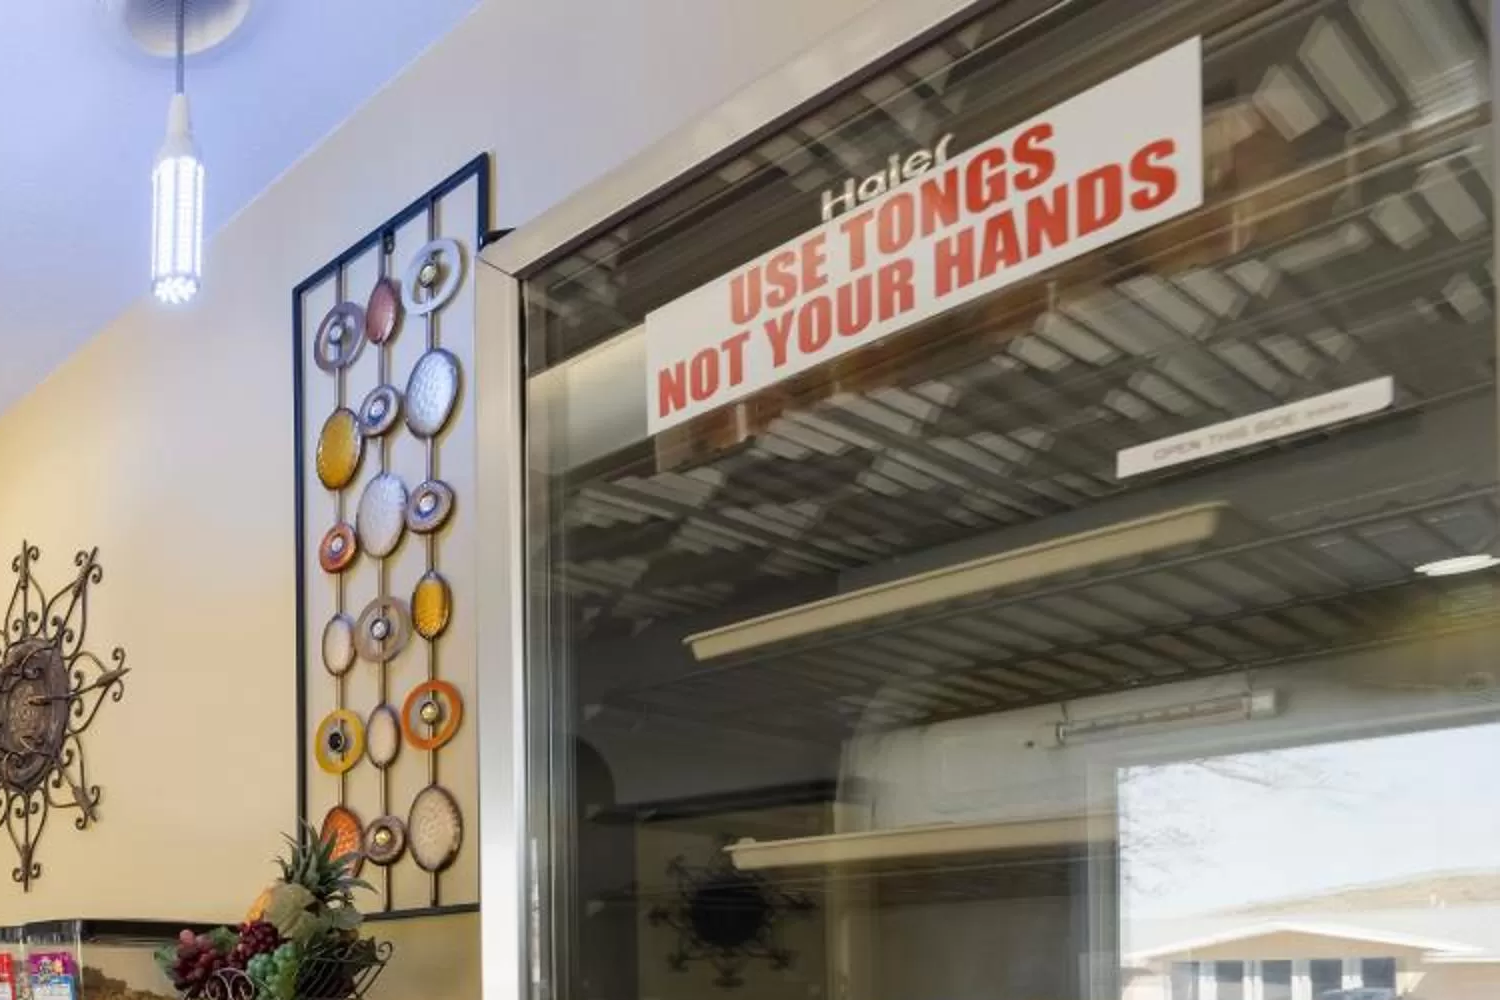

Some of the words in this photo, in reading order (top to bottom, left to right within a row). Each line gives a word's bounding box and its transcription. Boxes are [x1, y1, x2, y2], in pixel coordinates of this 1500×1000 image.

[657, 330, 750, 419] NOT
[763, 256, 915, 369] YOUR
[934, 137, 1178, 299] HANDS
[729, 240, 828, 326] USE
[840, 122, 1056, 272] TONGS
[820, 132, 955, 222] Haier
